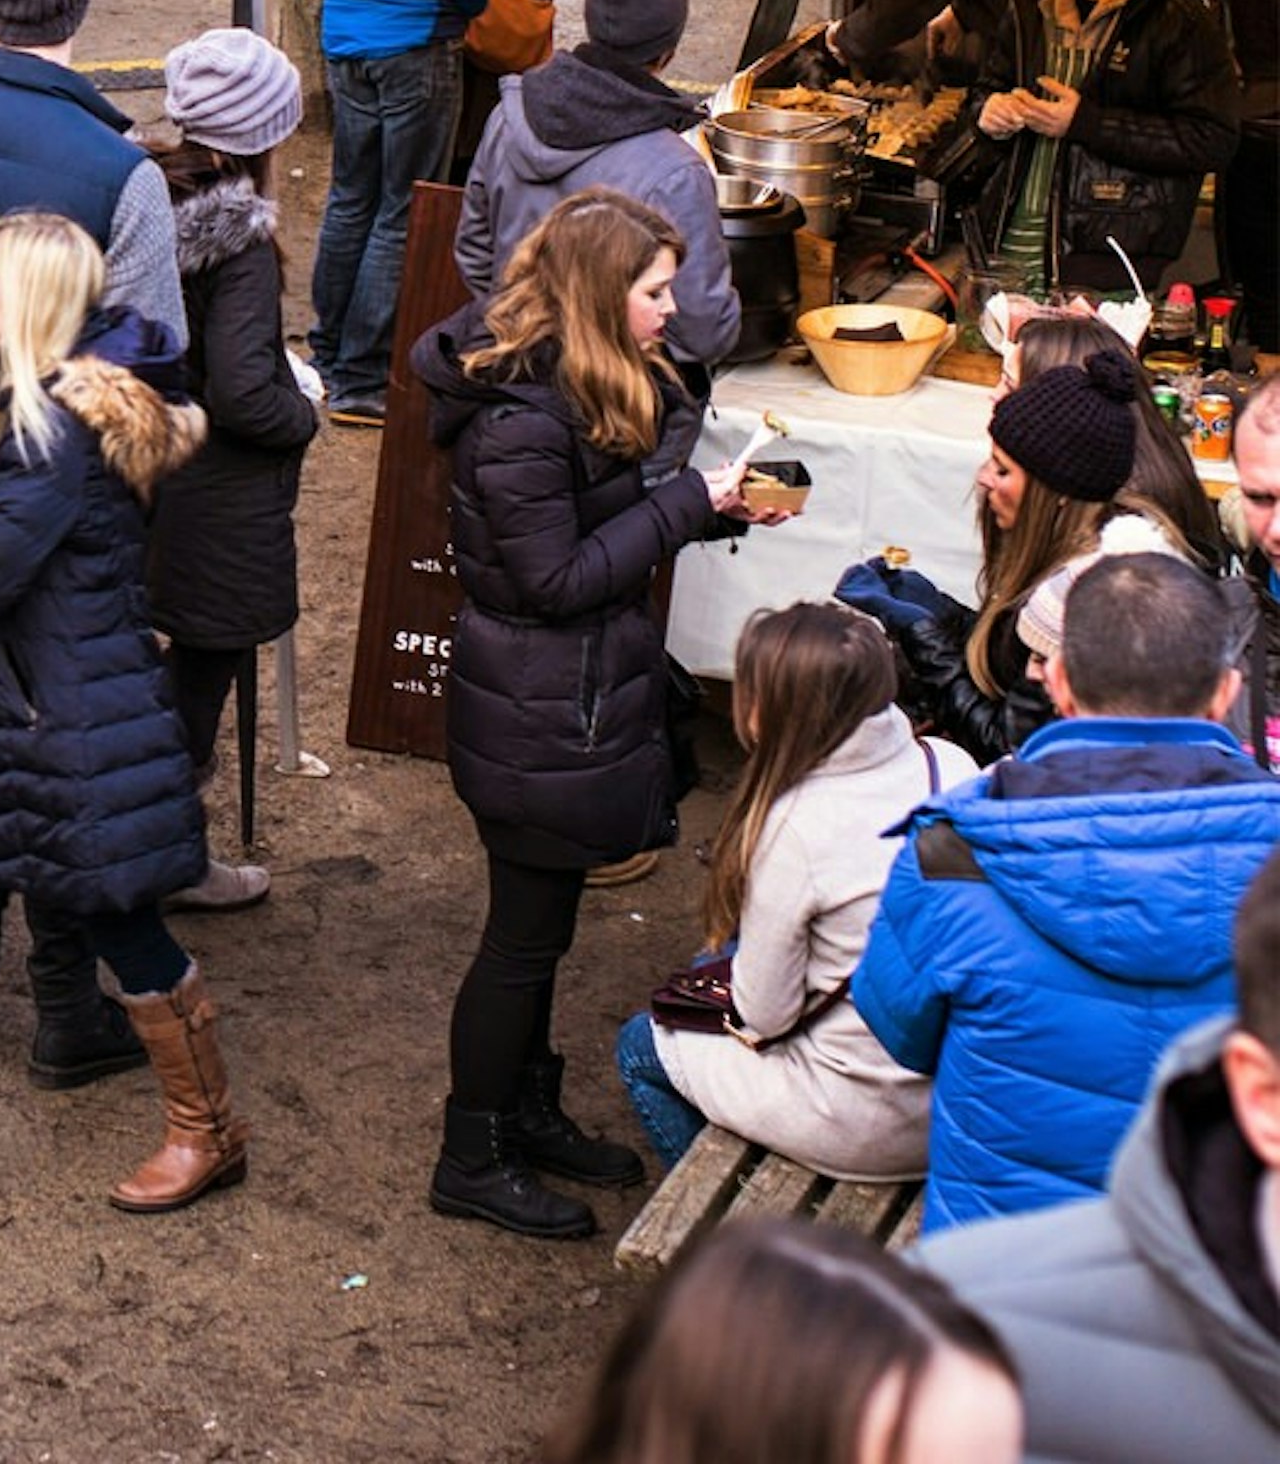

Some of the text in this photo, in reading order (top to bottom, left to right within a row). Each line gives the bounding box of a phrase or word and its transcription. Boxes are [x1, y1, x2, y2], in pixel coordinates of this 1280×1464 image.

[410, 558, 443, 574] with
[393, 630, 453, 659] SPEC
[392, 678, 427, 695] with
